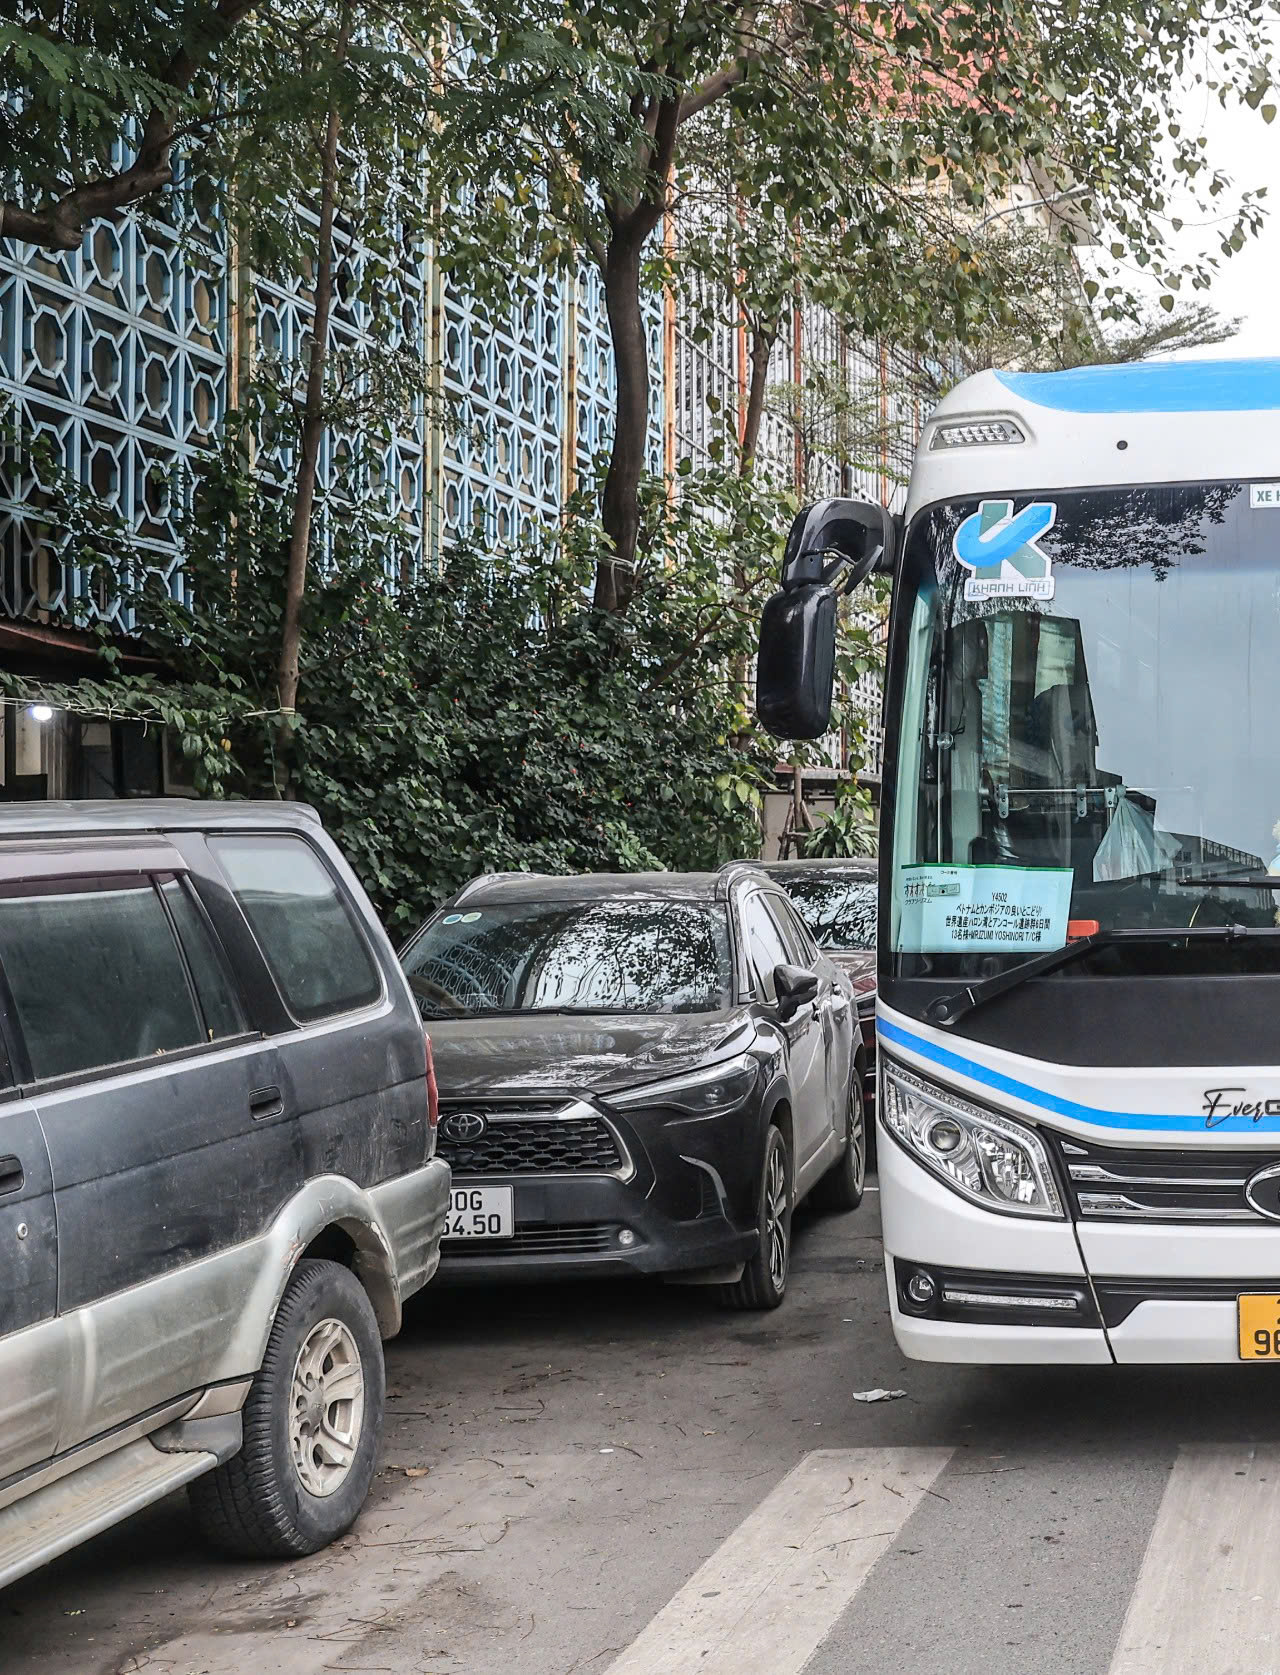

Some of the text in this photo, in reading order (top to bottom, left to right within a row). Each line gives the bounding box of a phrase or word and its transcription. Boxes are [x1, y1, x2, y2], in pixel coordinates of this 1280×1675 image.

[1256, 490, 1272, 502] XE
[972, 583, 1046, 593] KHANH LINH
[449, 1190, 482, 1211] 0G
